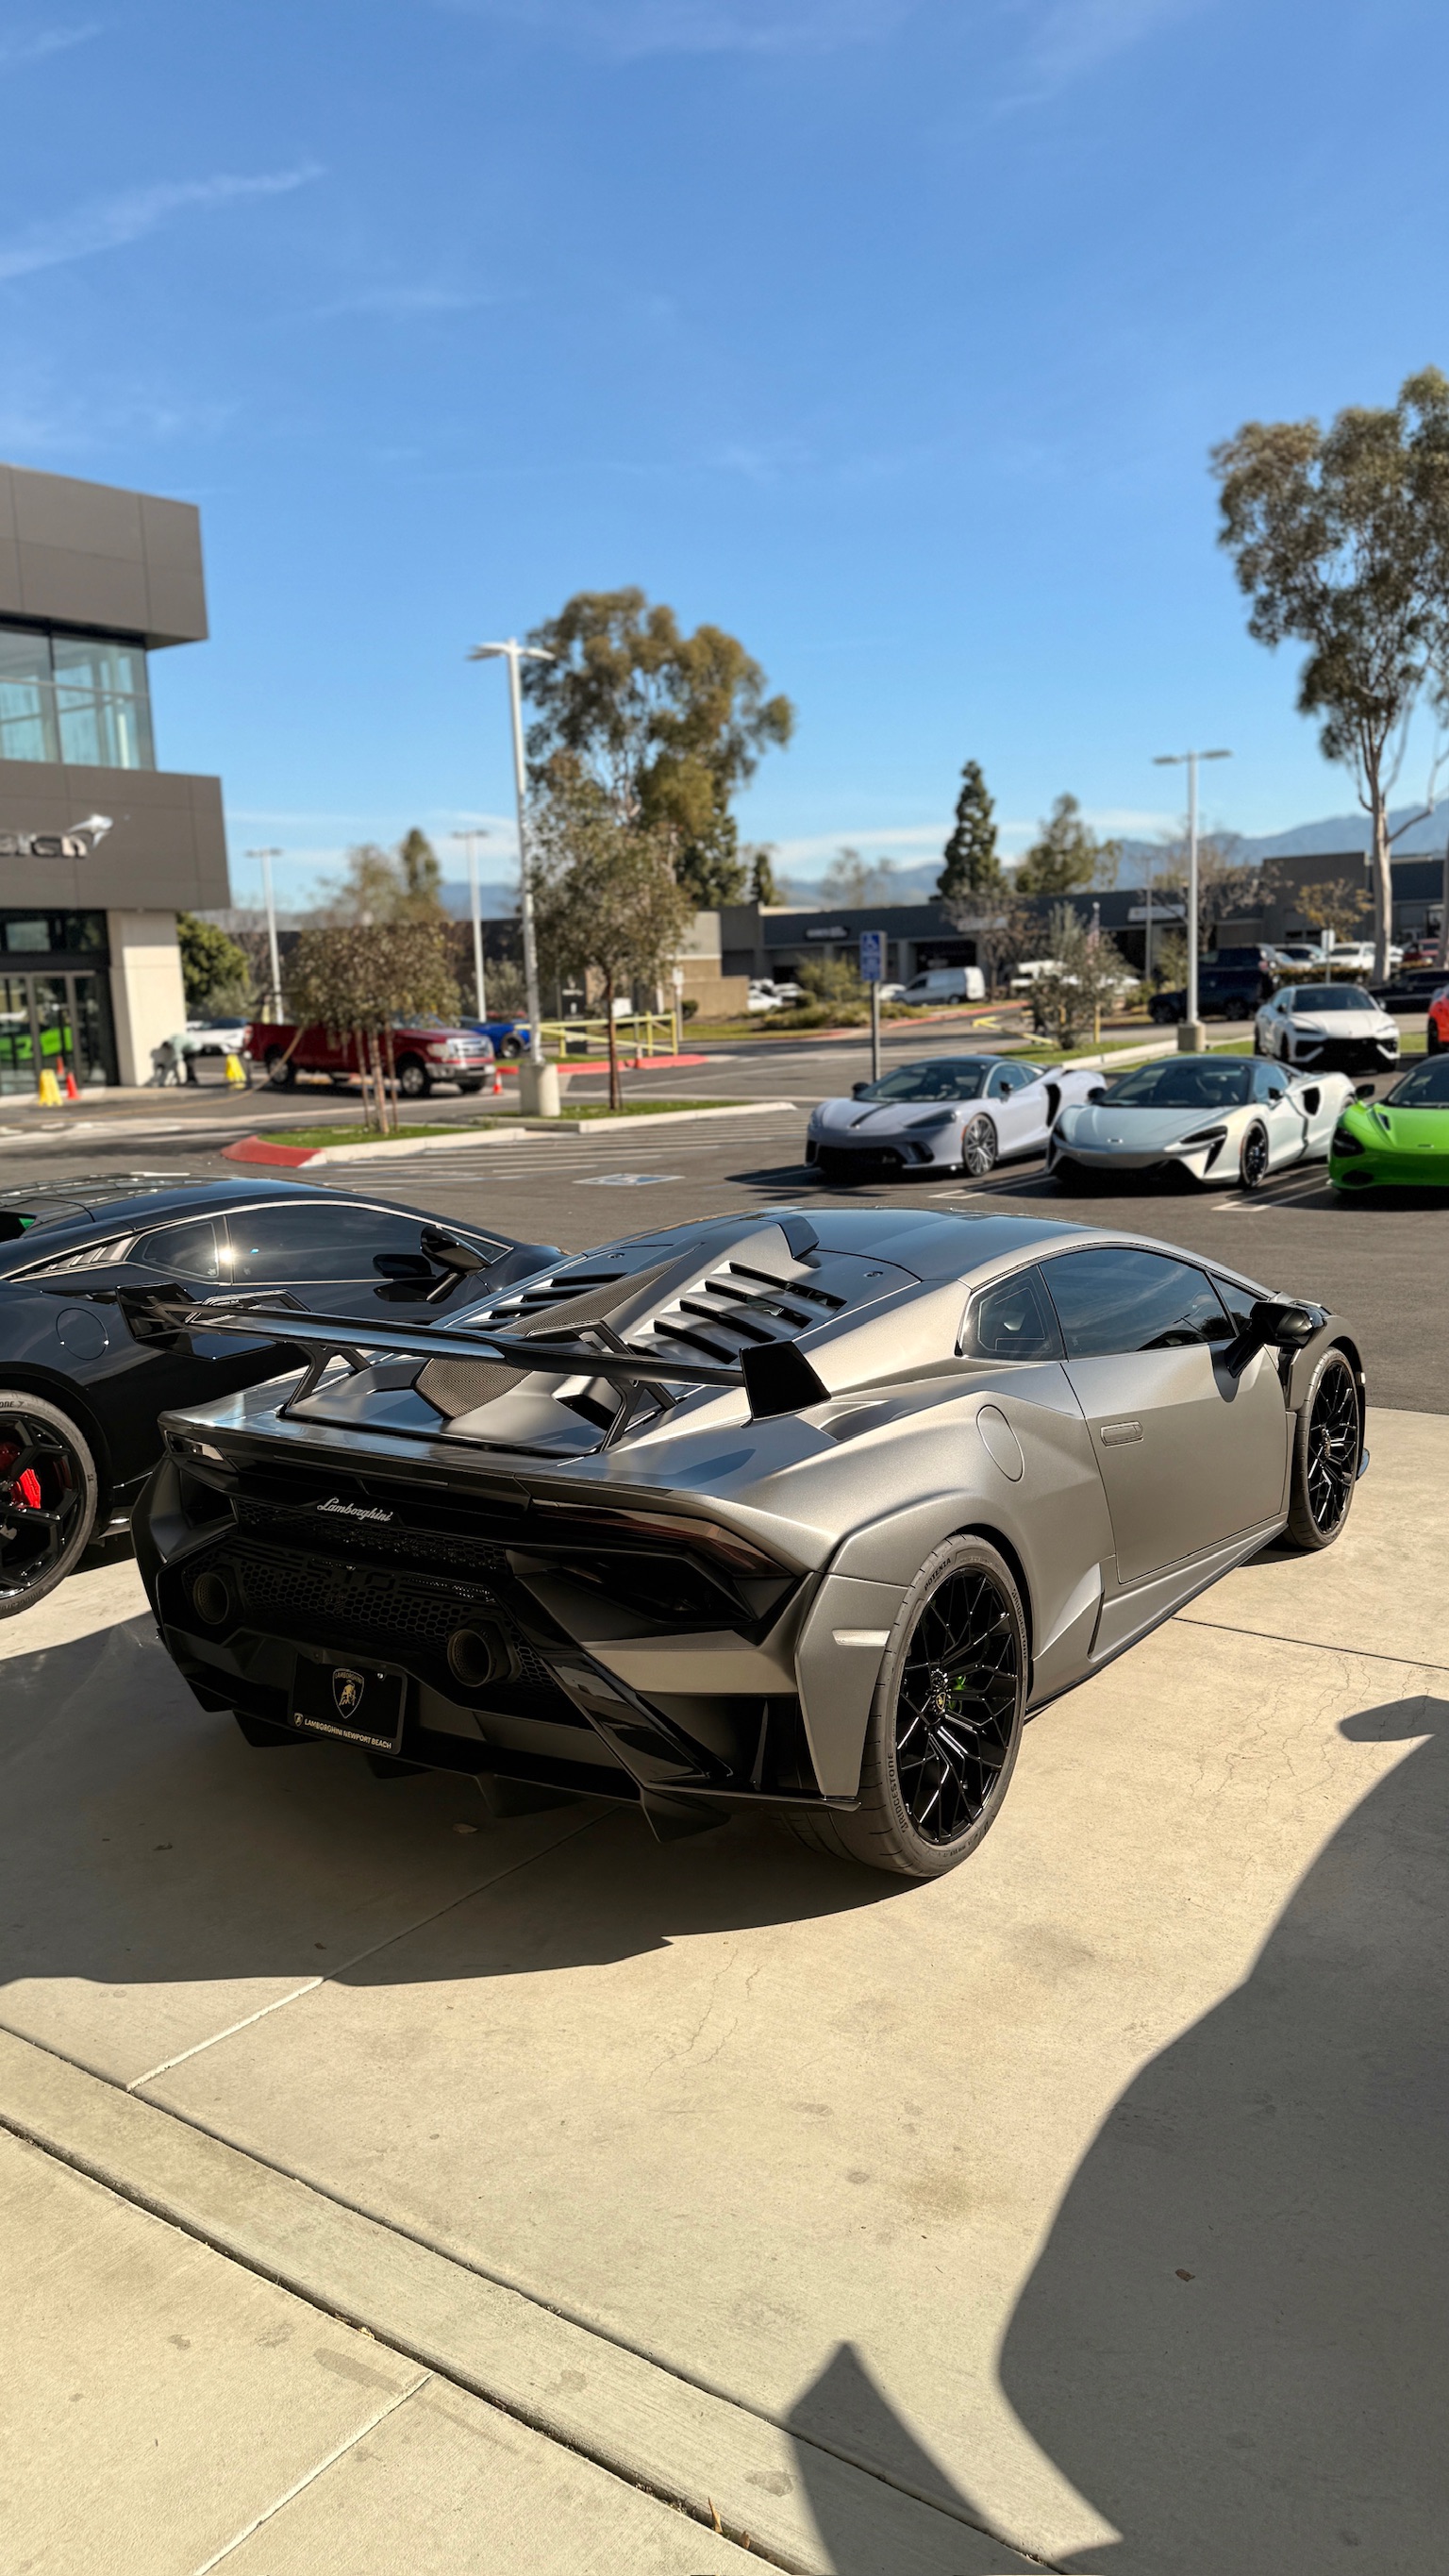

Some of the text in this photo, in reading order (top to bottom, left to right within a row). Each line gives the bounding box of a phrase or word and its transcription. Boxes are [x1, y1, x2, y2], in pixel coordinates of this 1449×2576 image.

[317, 1497, 393, 1522] Lamborghini
[304, 1718, 391, 1749] LAMBORGHINI NEWPORT BEACH
[888, 1752, 908, 1833] BRIDGESTONE
